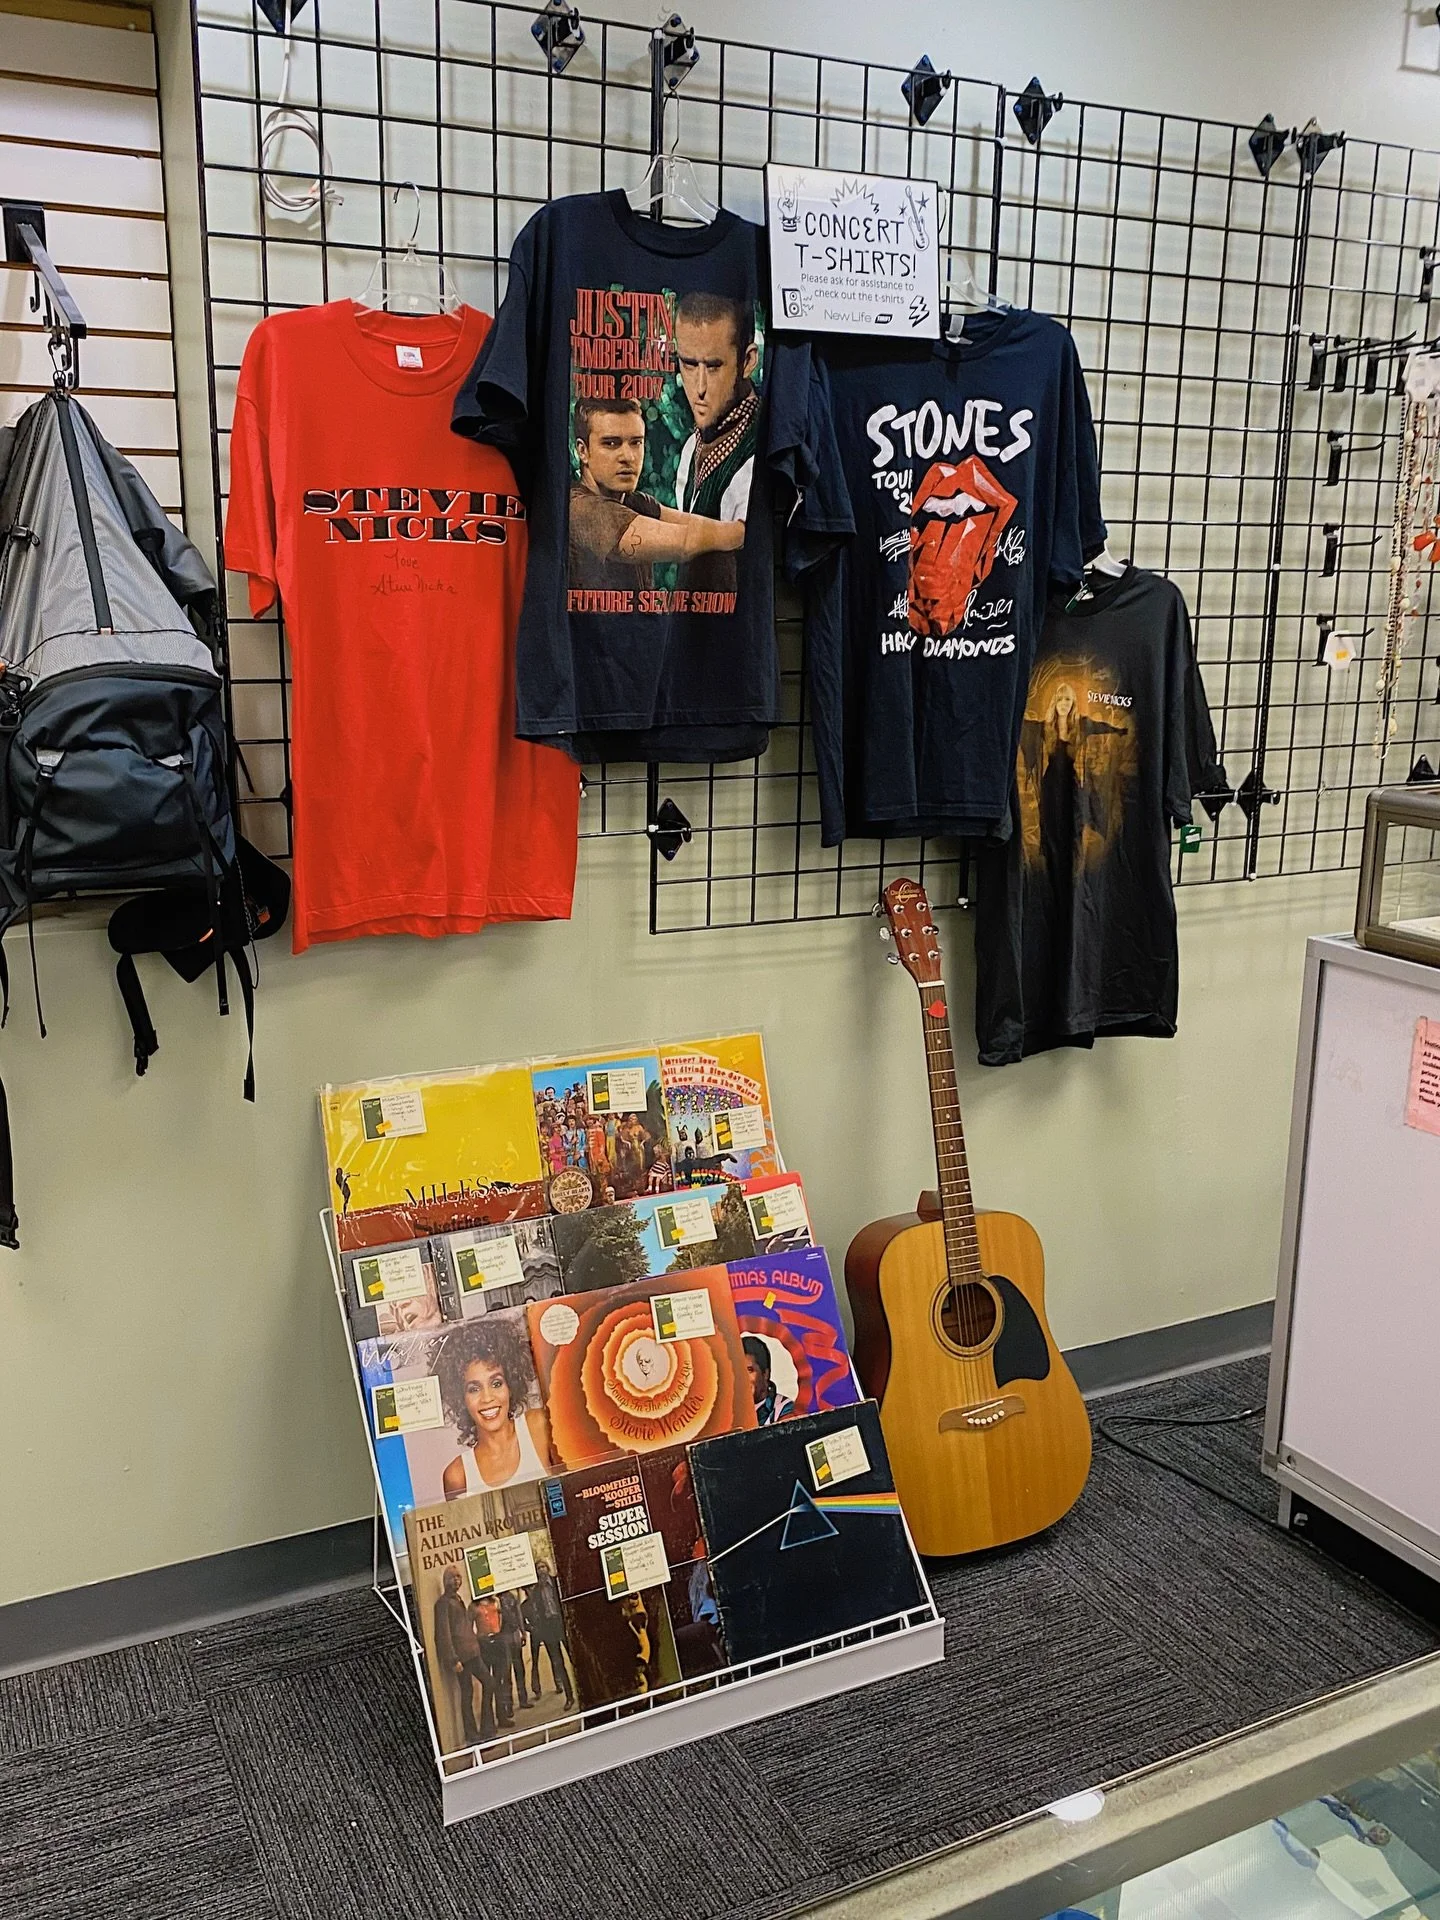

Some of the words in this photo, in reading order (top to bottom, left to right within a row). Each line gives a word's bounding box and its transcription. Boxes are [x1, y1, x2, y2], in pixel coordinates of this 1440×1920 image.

[805, 212, 904, 244] CONCERT
[795, 243, 917, 279] T-SHIRTS!
[801, 274, 828, 284] Please
[830, 276, 844, 285] ask
[846, 277, 858, 287] for
[861, 279, 903, 290] assistance
[905, 282, 914, 291] to
[814, 289, 839, 298] check
[841, 291, 856, 301] out
[858, 292, 873, 301] the
[875, 293, 905, 304] t-shirts
[569, 288, 676, 341] JUSTIN
[824, 310, 849, 321] New
[852, 311, 872, 323] Life
[570, 335, 676, 372] TIMBERLAKE
[572, 373, 616, 400] TOUR
[620, 375, 664, 400] 2007
[866, 400, 1034, 468] STONES
[303, 488, 527, 521] STEVIE
[324, 516, 508, 545] NICKS
[567, 589, 634, 613] FUTURE
[691, 591, 738, 614] SHOW
[923, 634, 1015, 660] DIAMONDS
[772, 1269, 824, 1294] ALBUM
[608, 1416, 656, 1441] Stevie
[653, 1394, 704, 1438] Wonder
[582, 1476, 639, 1498] BLOOMFIELD
[604, 1484, 641, 1502] KOOPER
[614, 1493, 643, 1509] STILLS
[416, 1514, 445, 1533] THE
[598, 1505, 647, 1531] SUPER
[421, 1524, 481, 1552] ALLMAN
[588, 1519, 649, 1549] SESSION
[423, 1546, 465, 1570] BAND
